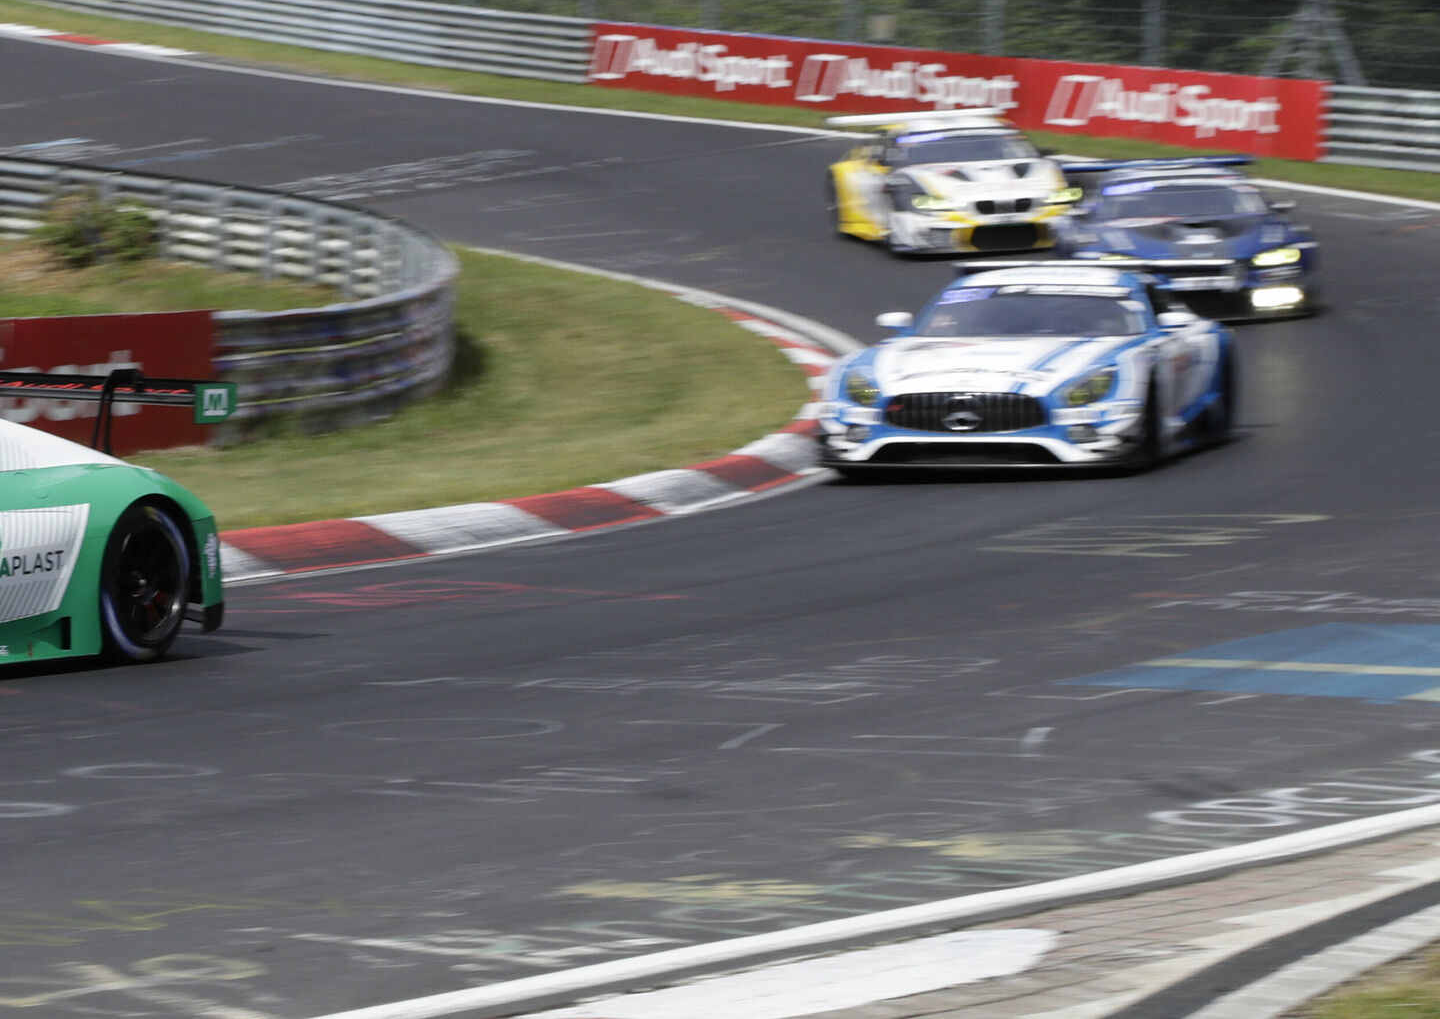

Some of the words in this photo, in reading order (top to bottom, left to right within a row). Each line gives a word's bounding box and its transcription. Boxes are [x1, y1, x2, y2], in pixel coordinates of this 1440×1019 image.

[626, 38, 698, 77] Audi
[697, 44, 793, 91] Sport
[836, 58, 919, 99] Audi
[917, 63, 1019, 110] Sport
[1089, 79, 1178, 123] Audi
[1175, 85, 1281, 138] Sport
